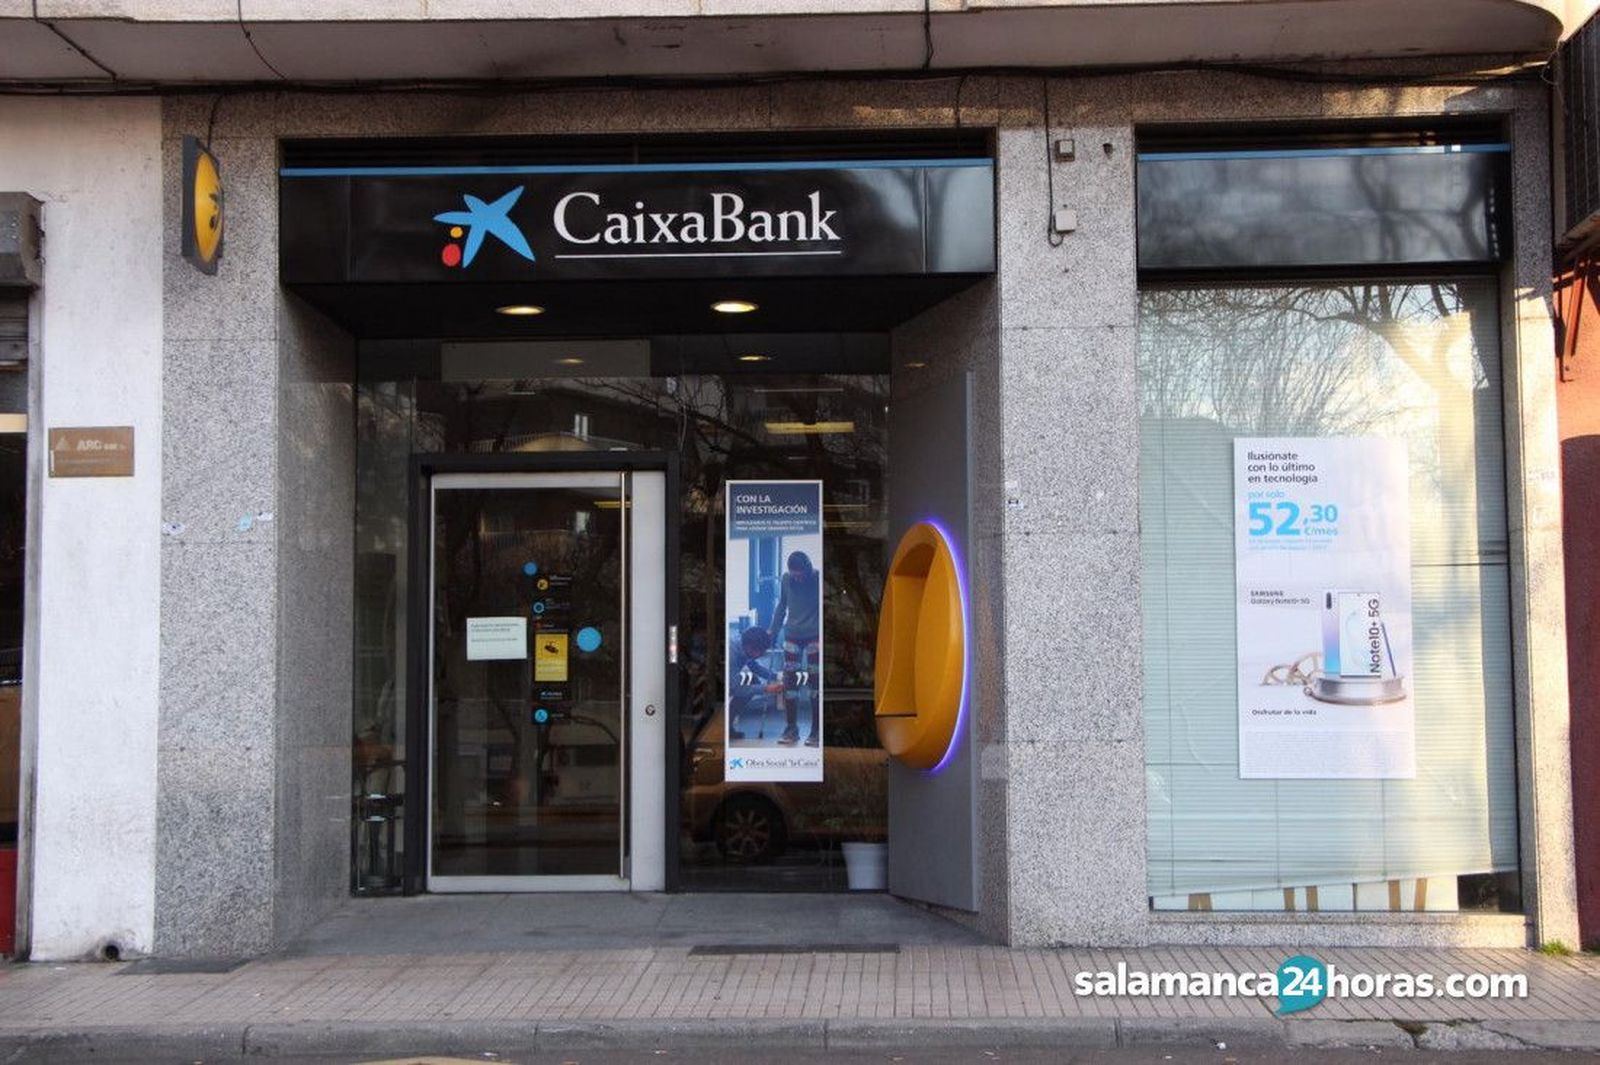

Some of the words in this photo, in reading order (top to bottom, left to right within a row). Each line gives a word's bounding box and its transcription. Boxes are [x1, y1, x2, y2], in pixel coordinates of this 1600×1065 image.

[553, 190, 841, 245] CaixaBank
[1247, 464, 1267, 472] con
[1269, 462, 1280, 472] lo
[1281, 462, 1316, 472] último
[1247, 475, 1261, 483] en
[736, 495, 757, 504] CON
[759, 494, 772, 503] LA
[1368, 599, 1380, 618] 5G
